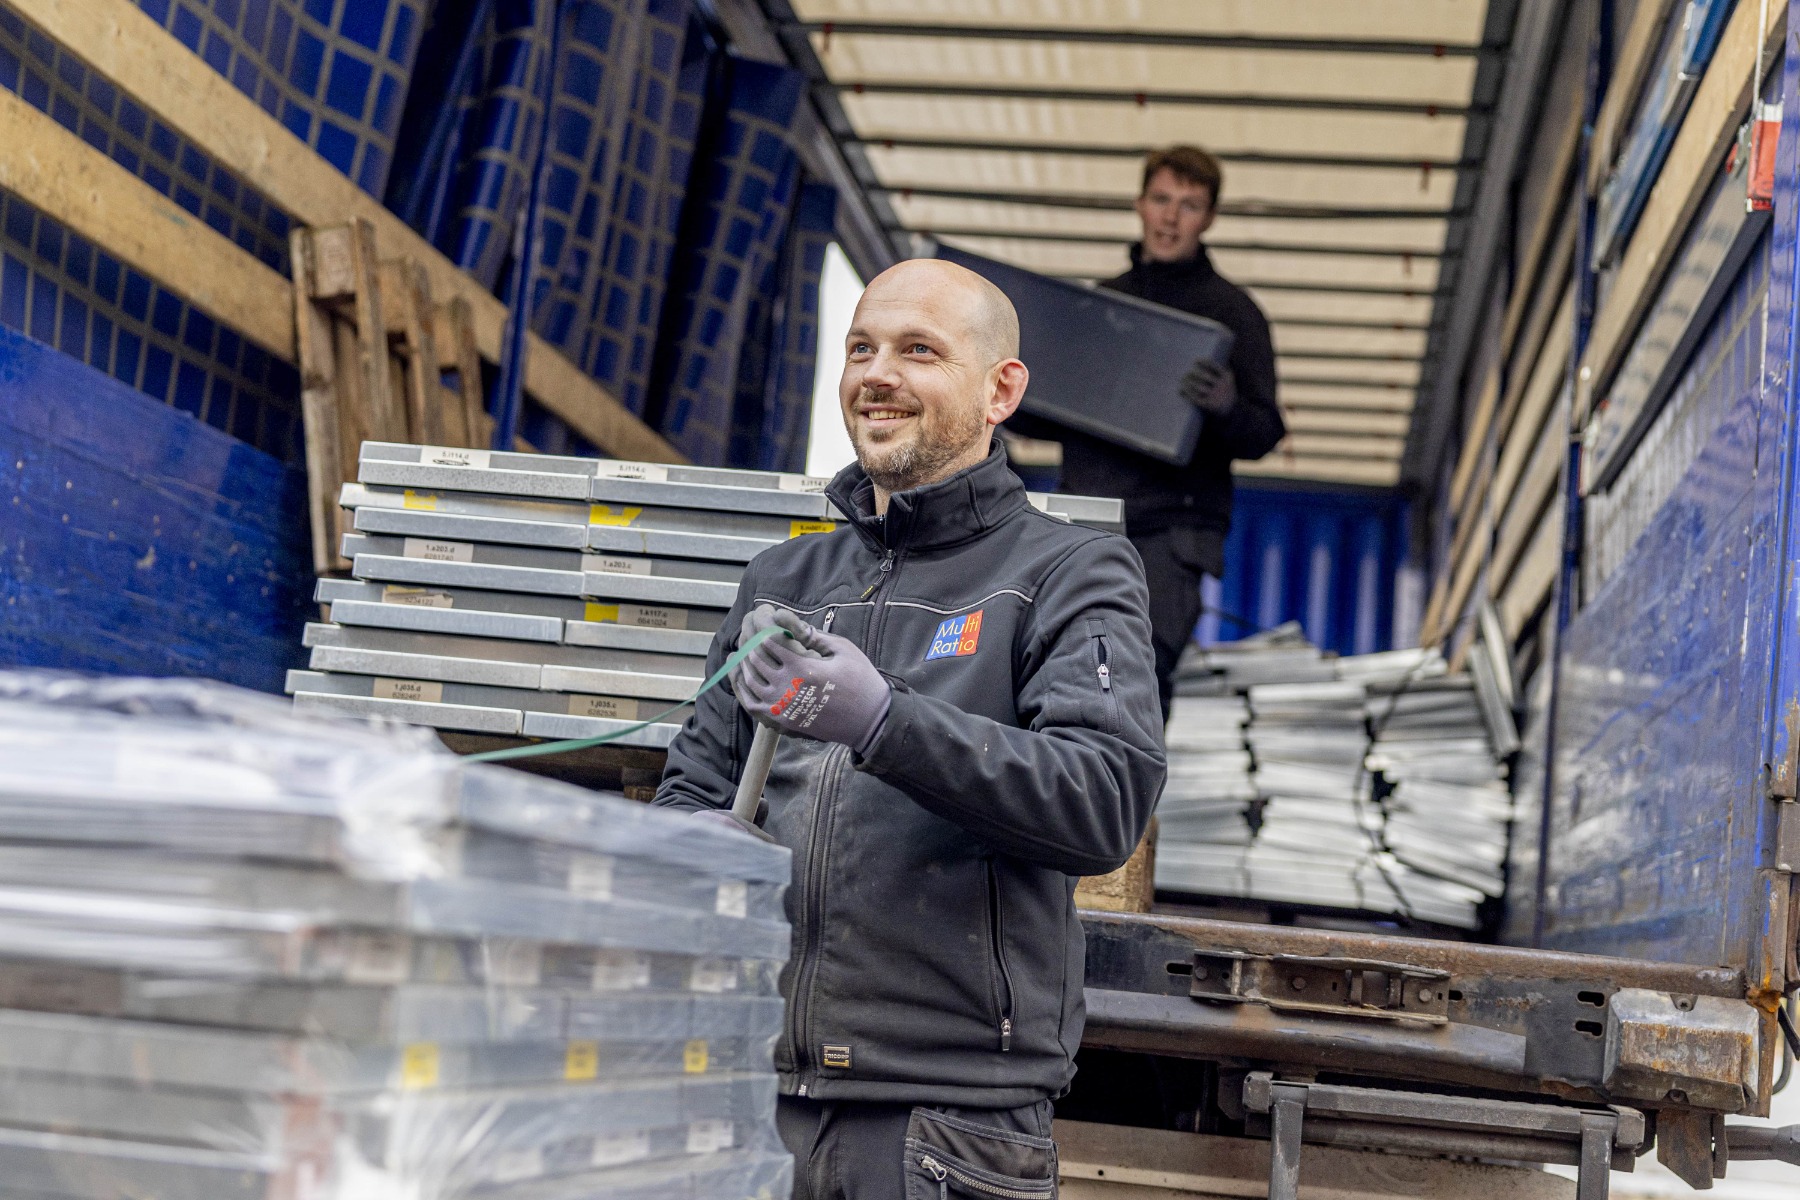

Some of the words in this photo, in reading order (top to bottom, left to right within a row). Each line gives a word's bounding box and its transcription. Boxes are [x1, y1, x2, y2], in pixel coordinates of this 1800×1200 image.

[936, 615, 980, 639] Multi
[930, 637, 975, 656] Ratio
[770, 677, 804, 716] OXXA
[788, 685, 818, 721] NITRI-TECH
